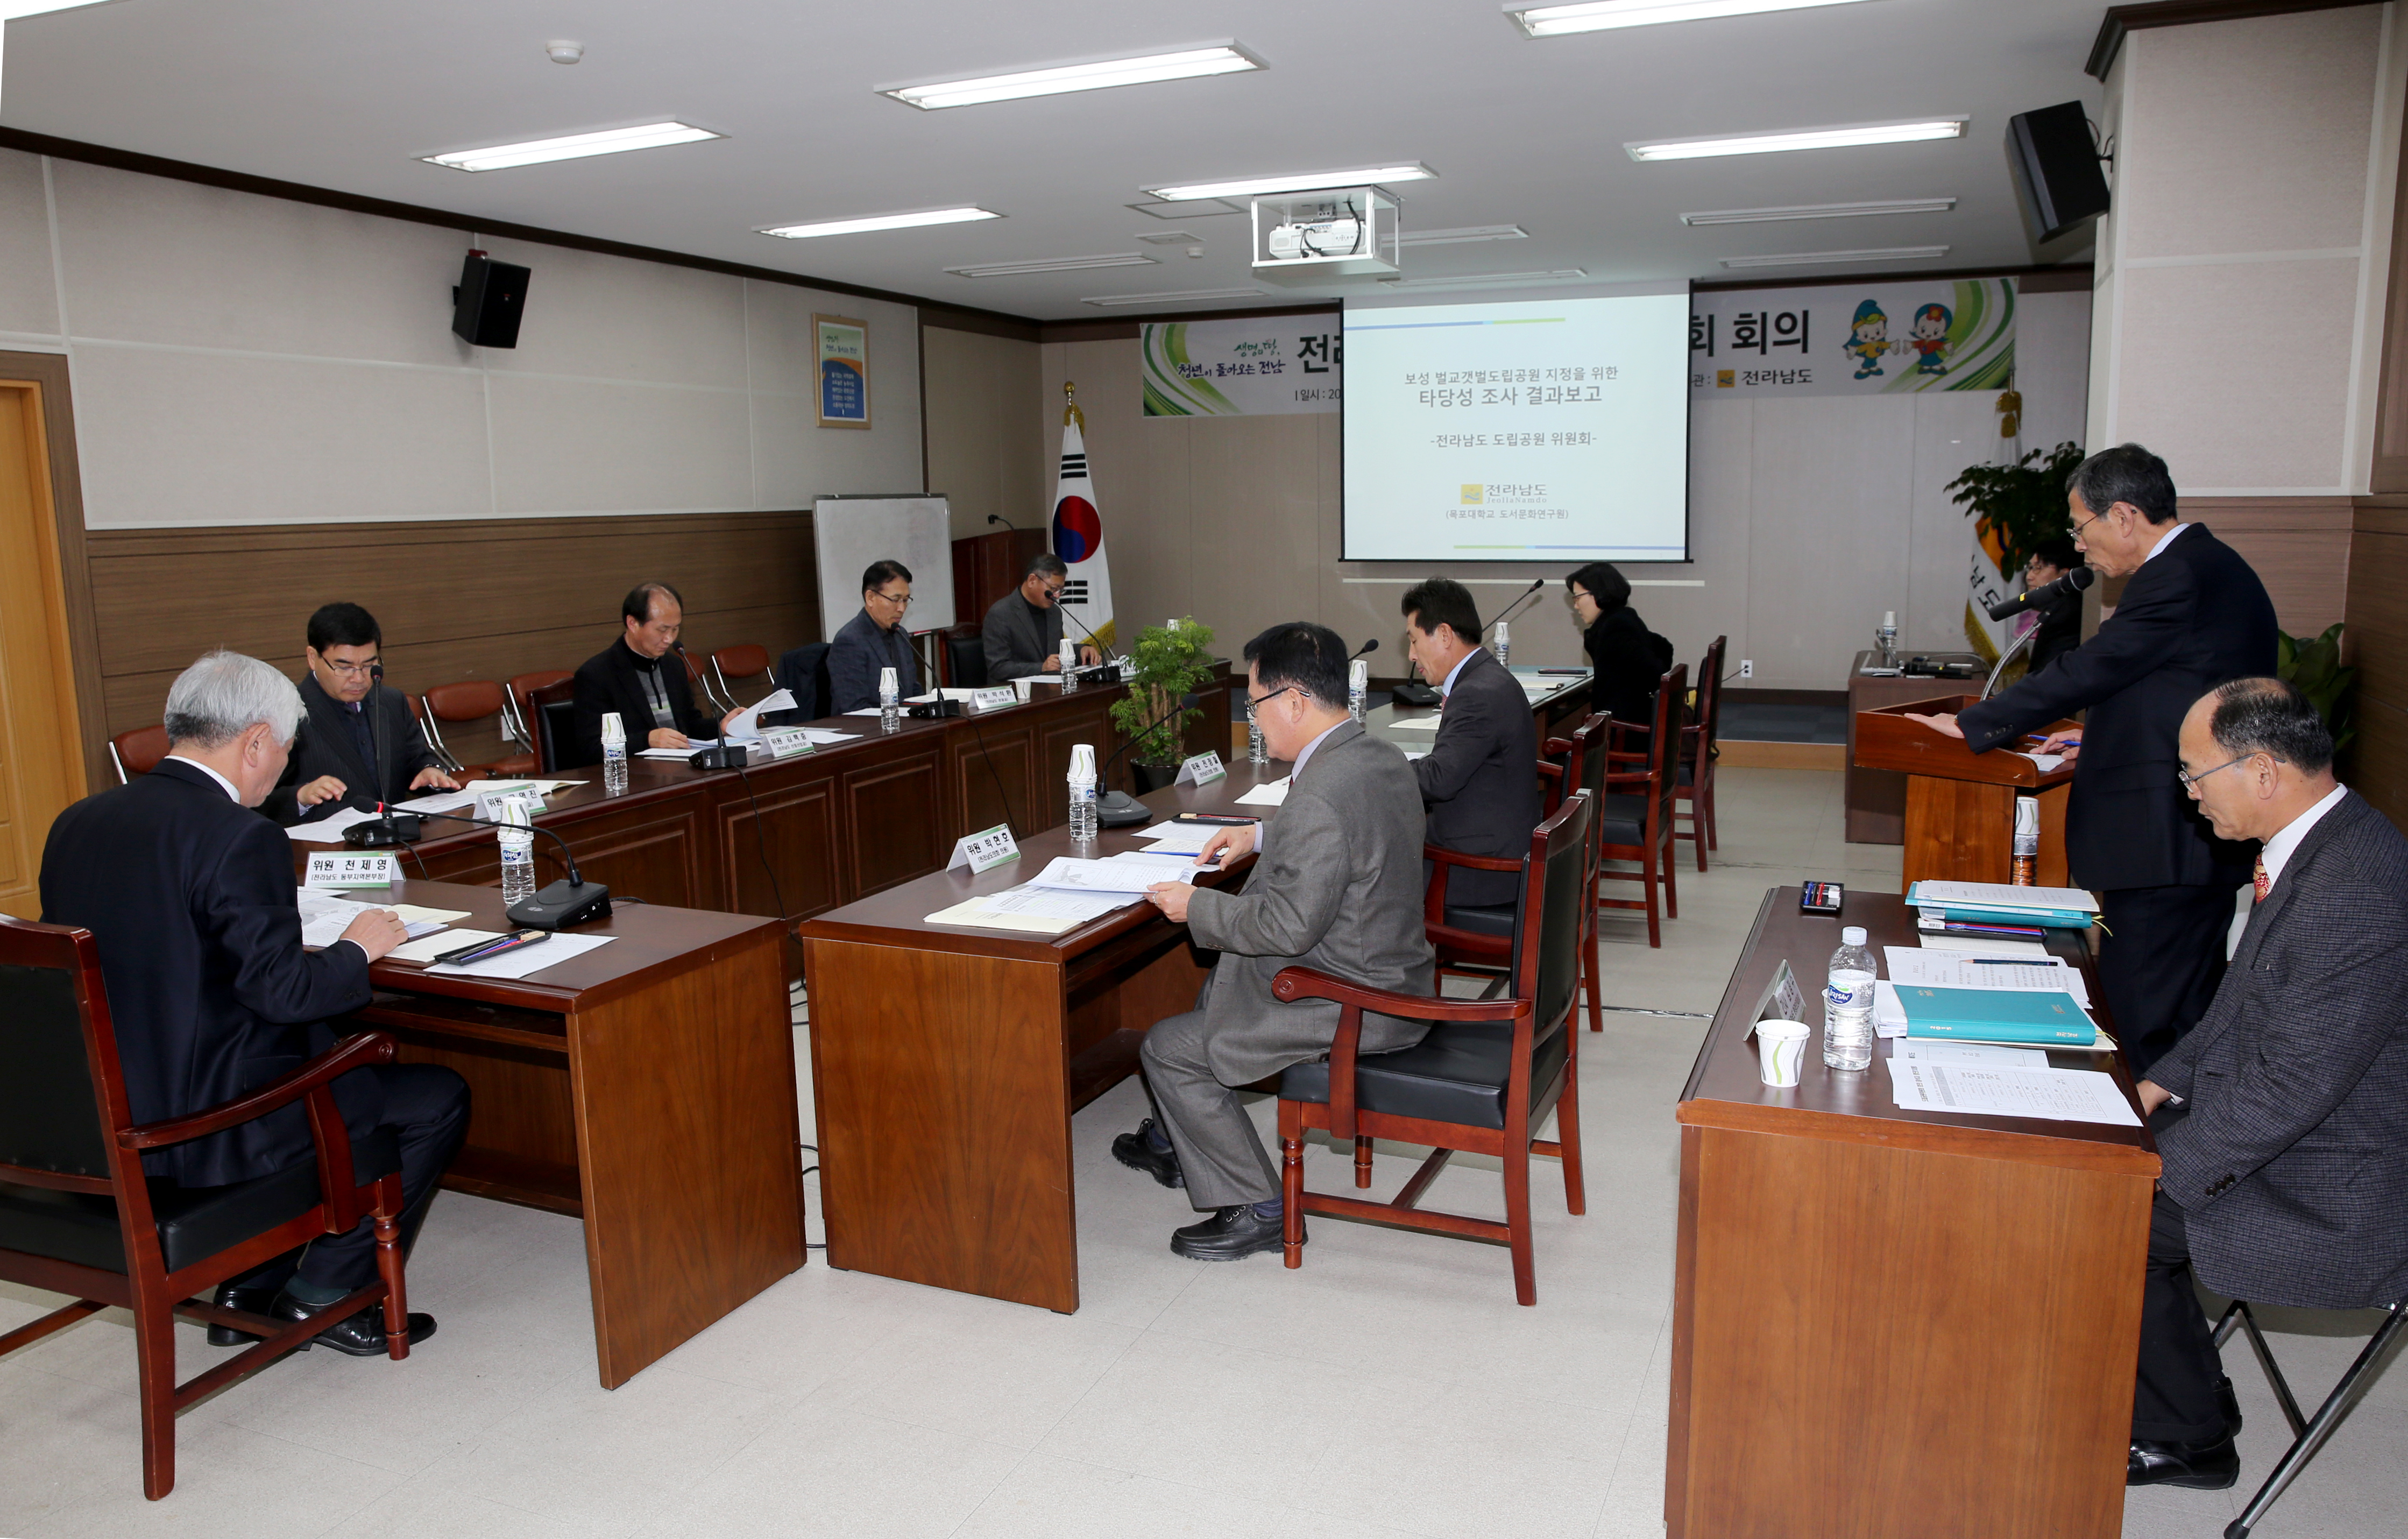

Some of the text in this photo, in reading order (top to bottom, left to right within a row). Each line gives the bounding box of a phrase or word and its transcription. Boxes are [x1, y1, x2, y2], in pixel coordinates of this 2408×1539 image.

[1732, 309, 1809, 355] 회의
[1297, 334, 1340, 373] 전
[1178, 359, 1286, 378] 청년이 돌아오는 전남
[1404, 365, 1619, 386] 보성 벌교갯벌도립공원 지정을 위한
[1741, 369, 1812, 385] 전라남도
[1419, 385, 1603, 408] 타당성 조사 결과보고
[1492, 432, 1546, 447] 도립공원
[1485, 484, 1547, 496] 전라남도
[1499, 509, 1569, 519] 도서문화연구원)
[771, 737, 783, 745] 위원
[1191, 762, 1201, 772] 위원
[487, 796, 502, 807] 위원
[967, 842, 982, 856] 위원
[313, 860, 334, 871] 위원
